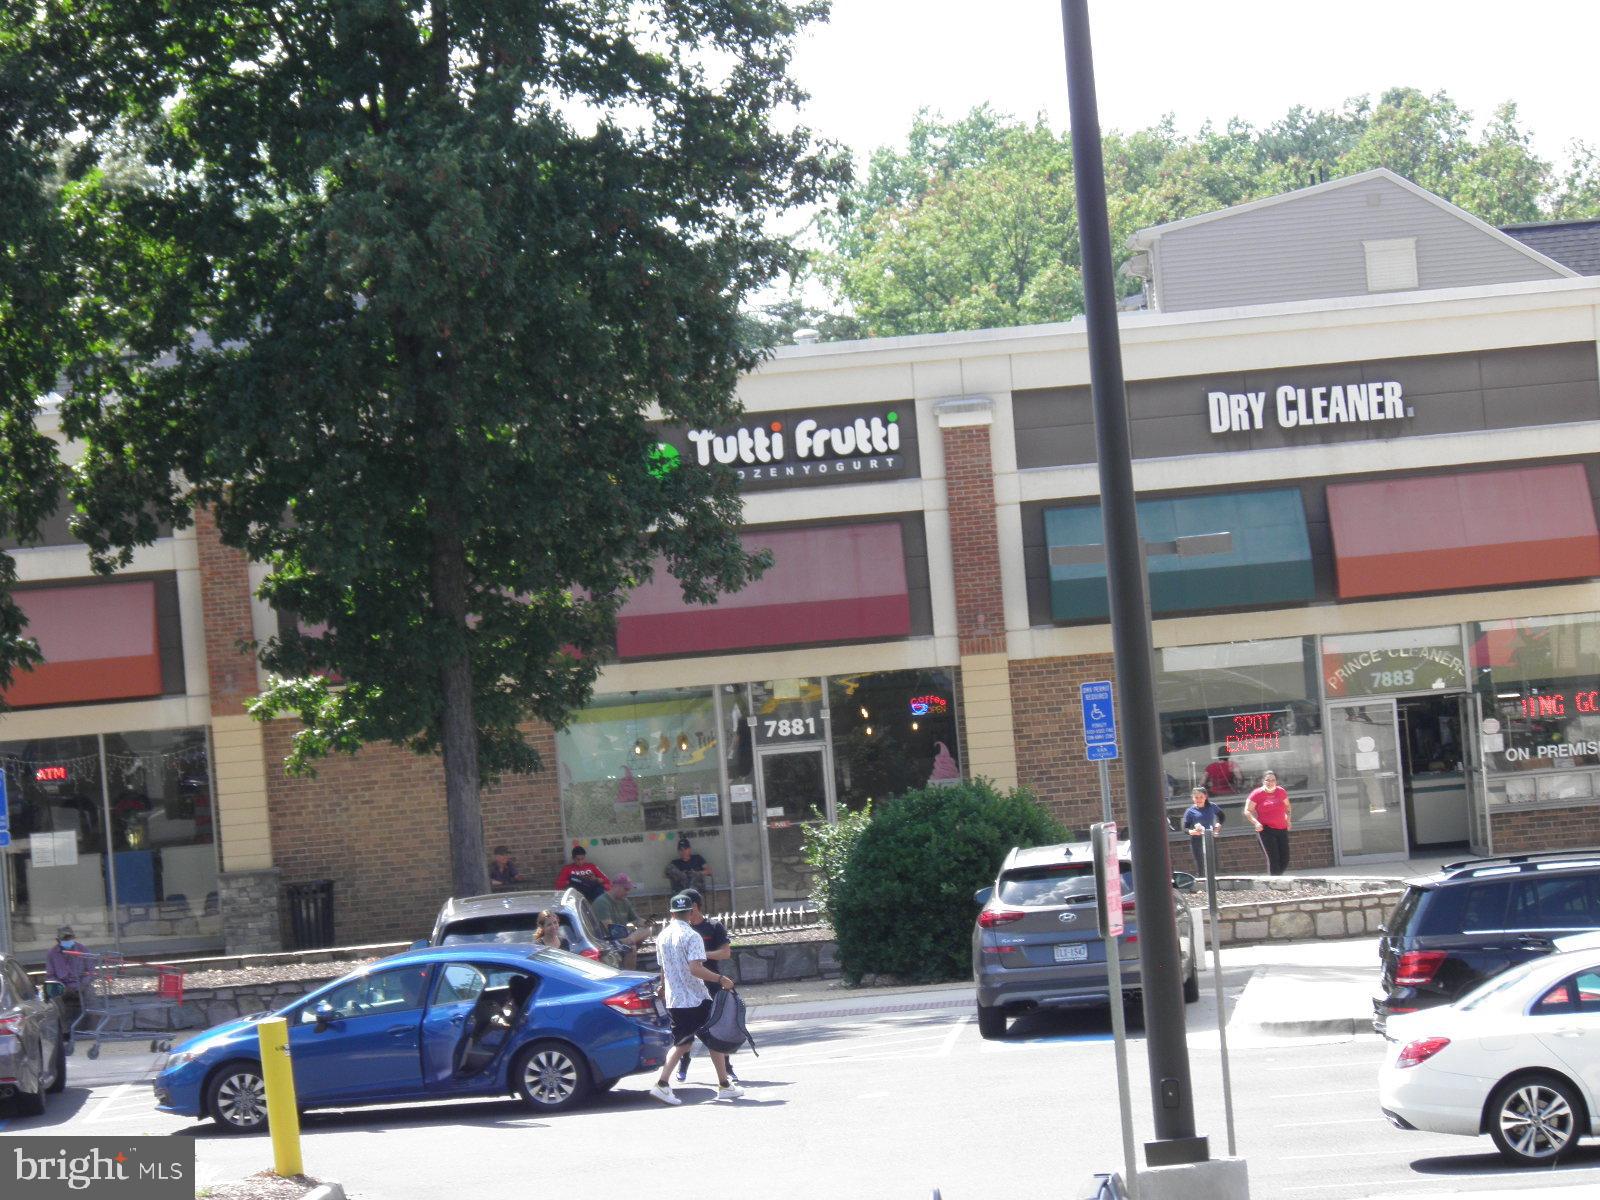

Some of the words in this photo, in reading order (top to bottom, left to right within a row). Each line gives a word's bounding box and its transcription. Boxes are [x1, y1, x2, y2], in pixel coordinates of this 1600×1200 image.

[1208, 391, 1266, 434] DRY
[1276, 381, 1404, 428] CLEANER
[688, 421, 784, 466] Tutti
[1328, 649, 1382, 690] PRINCE
[1370, 669, 1415, 688] 7883
[763, 717, 816, 737] 7881
[1233, 713, 1272, 733] SPOT
[1225, 731, 1280, 753] EXPERT
[1505, 747, 1530, 761] ON
[36, 767, 67, 781] ATM
